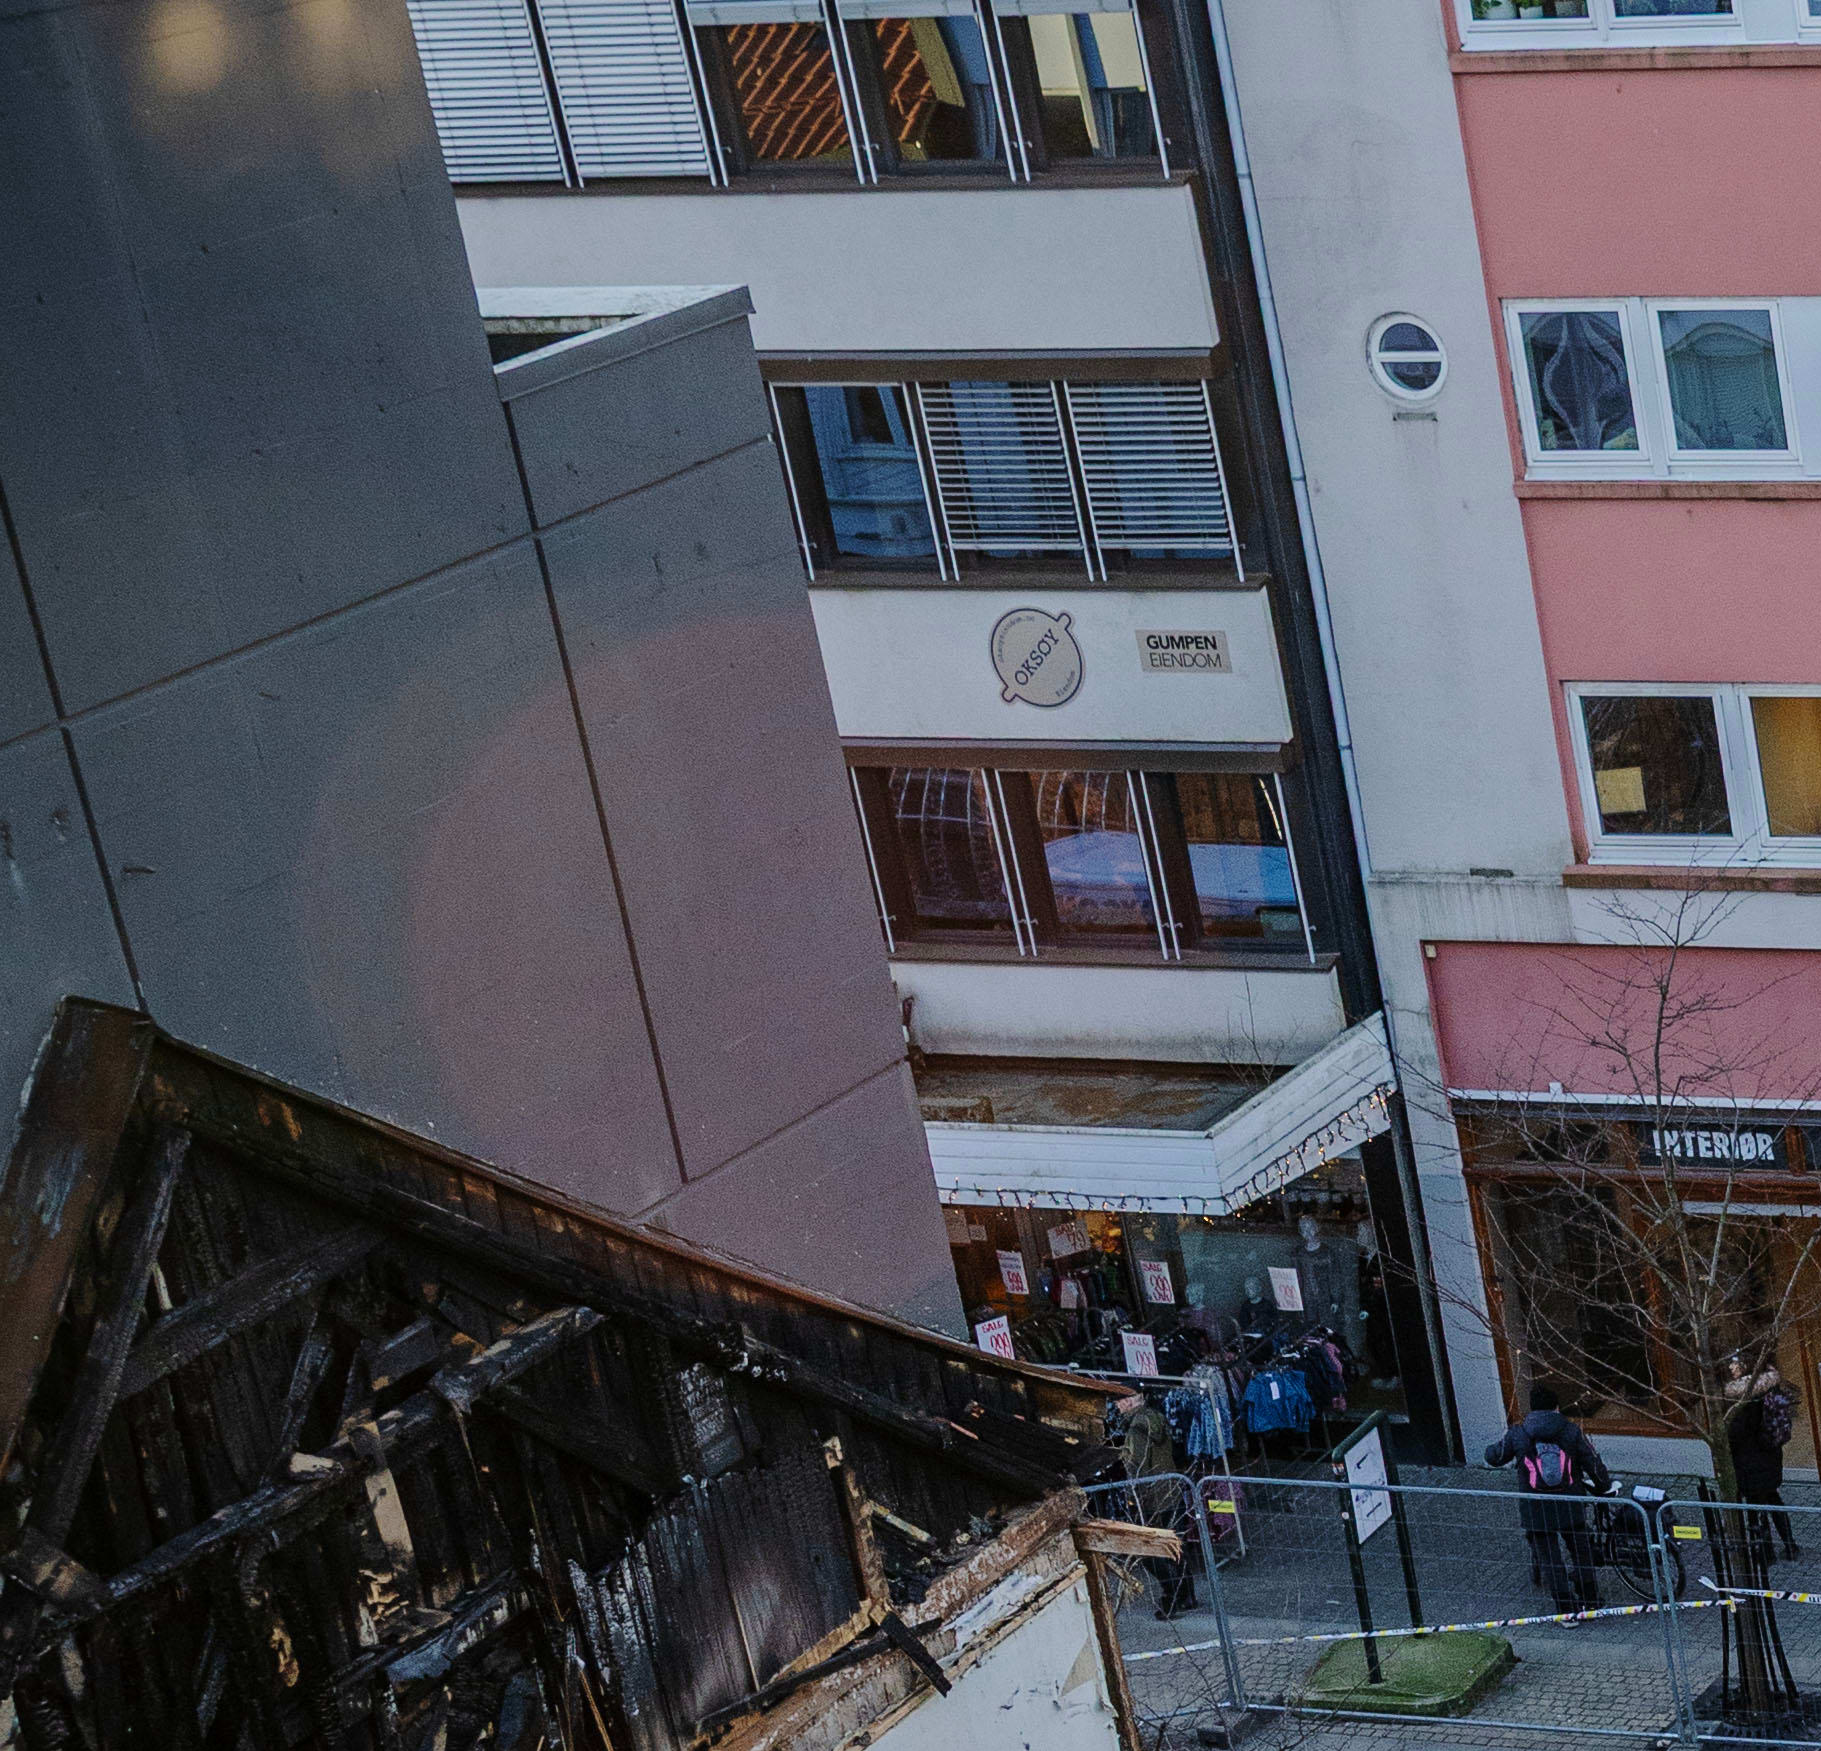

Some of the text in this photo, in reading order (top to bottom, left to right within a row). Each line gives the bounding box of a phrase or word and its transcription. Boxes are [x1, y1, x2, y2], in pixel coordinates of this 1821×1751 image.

[1146, 634, 1218, 651] GUMPEN
[1149, 652, 1223, 669] EIENDOM
[1652, 1129, 1775, 1162] INTERIØR
